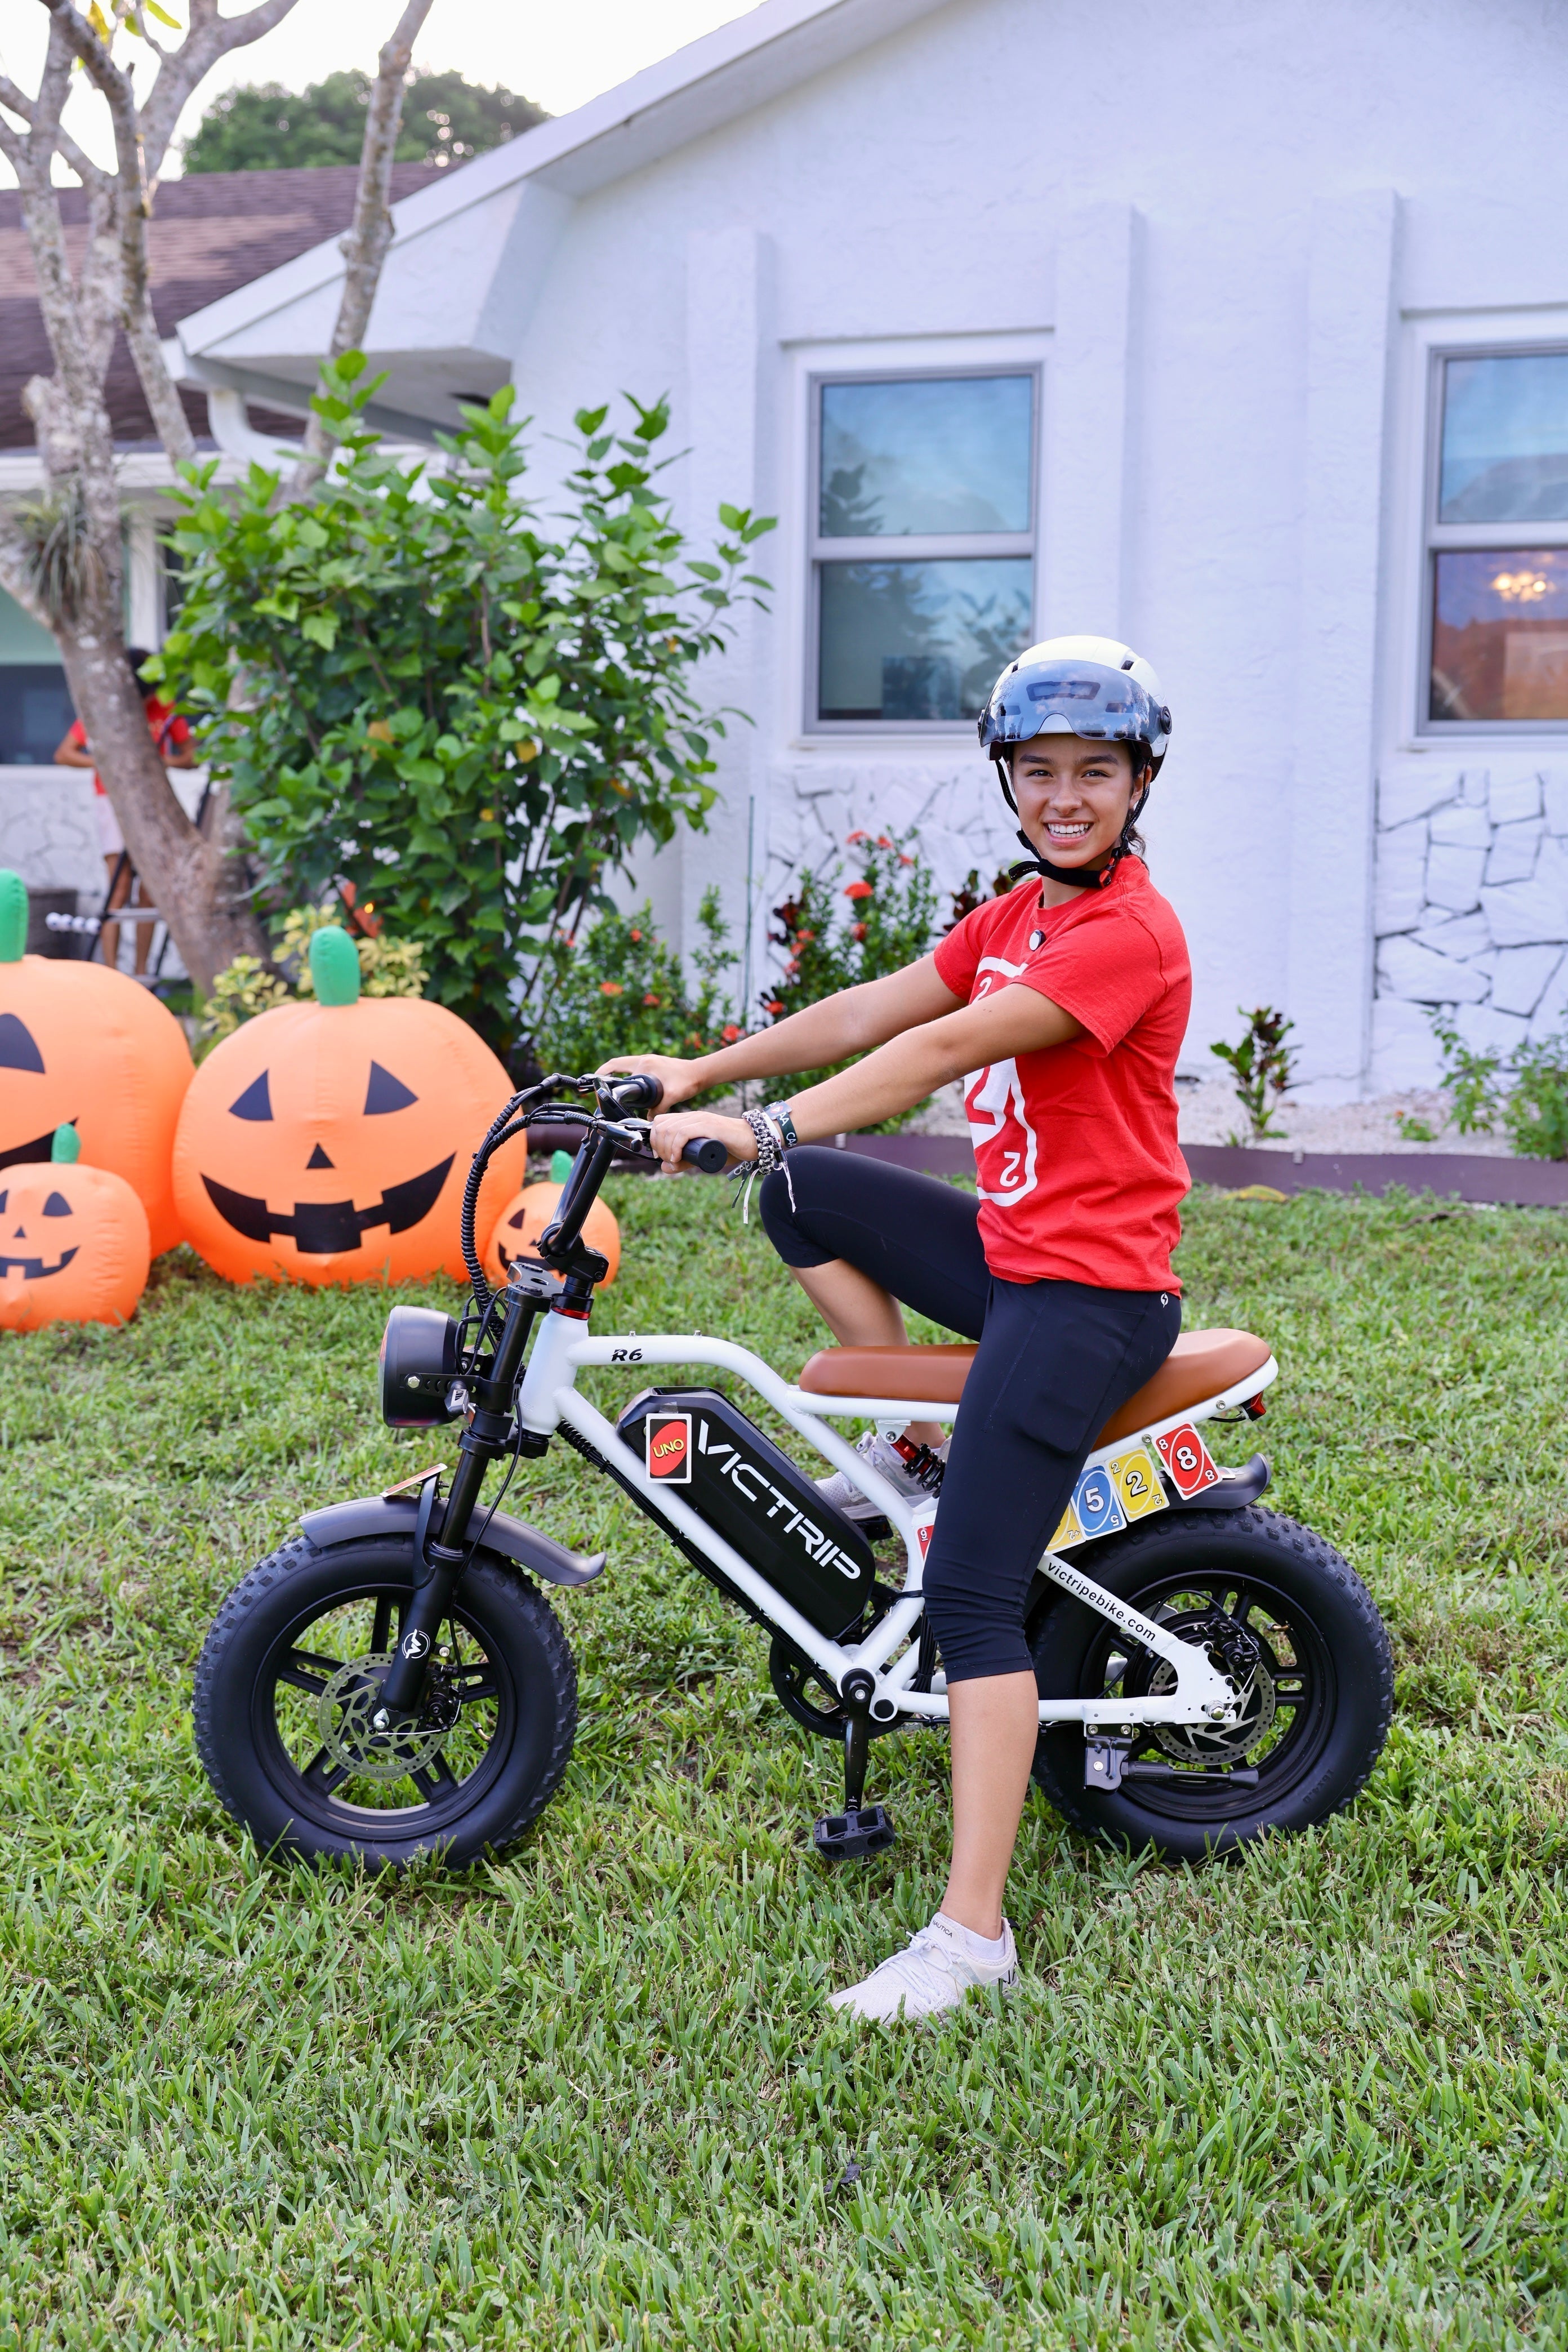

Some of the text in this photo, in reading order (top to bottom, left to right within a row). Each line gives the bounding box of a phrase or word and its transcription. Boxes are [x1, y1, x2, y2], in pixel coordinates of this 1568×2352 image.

[970, 977, 992, 1004] 2
[1000, 1151, 1021, 1187] 2
[611, 1348, 643, 1362] R6
[652, 1438, 685, 1459] UNO
[1159, 1438, 1169, 1451] 8
[1111, 1462, 1121, 1475] 2
[1176, 1446, 1197, 1471] 8
[1125, 1470, 1148, 1498] 2
[1204, 1469, 1215, 1482] 8
[697, 1419, 861, 1580] VICTRIP
[1084, 1486, 1104, 1513] 5
[1152, 1494, 1162, 1507] 2
[1110, 1514, 1120, 1527] 5
[1046, 1561, 1156, 1642] victripebike.com
[932, 1919, 952, 1938] NAUTICA
